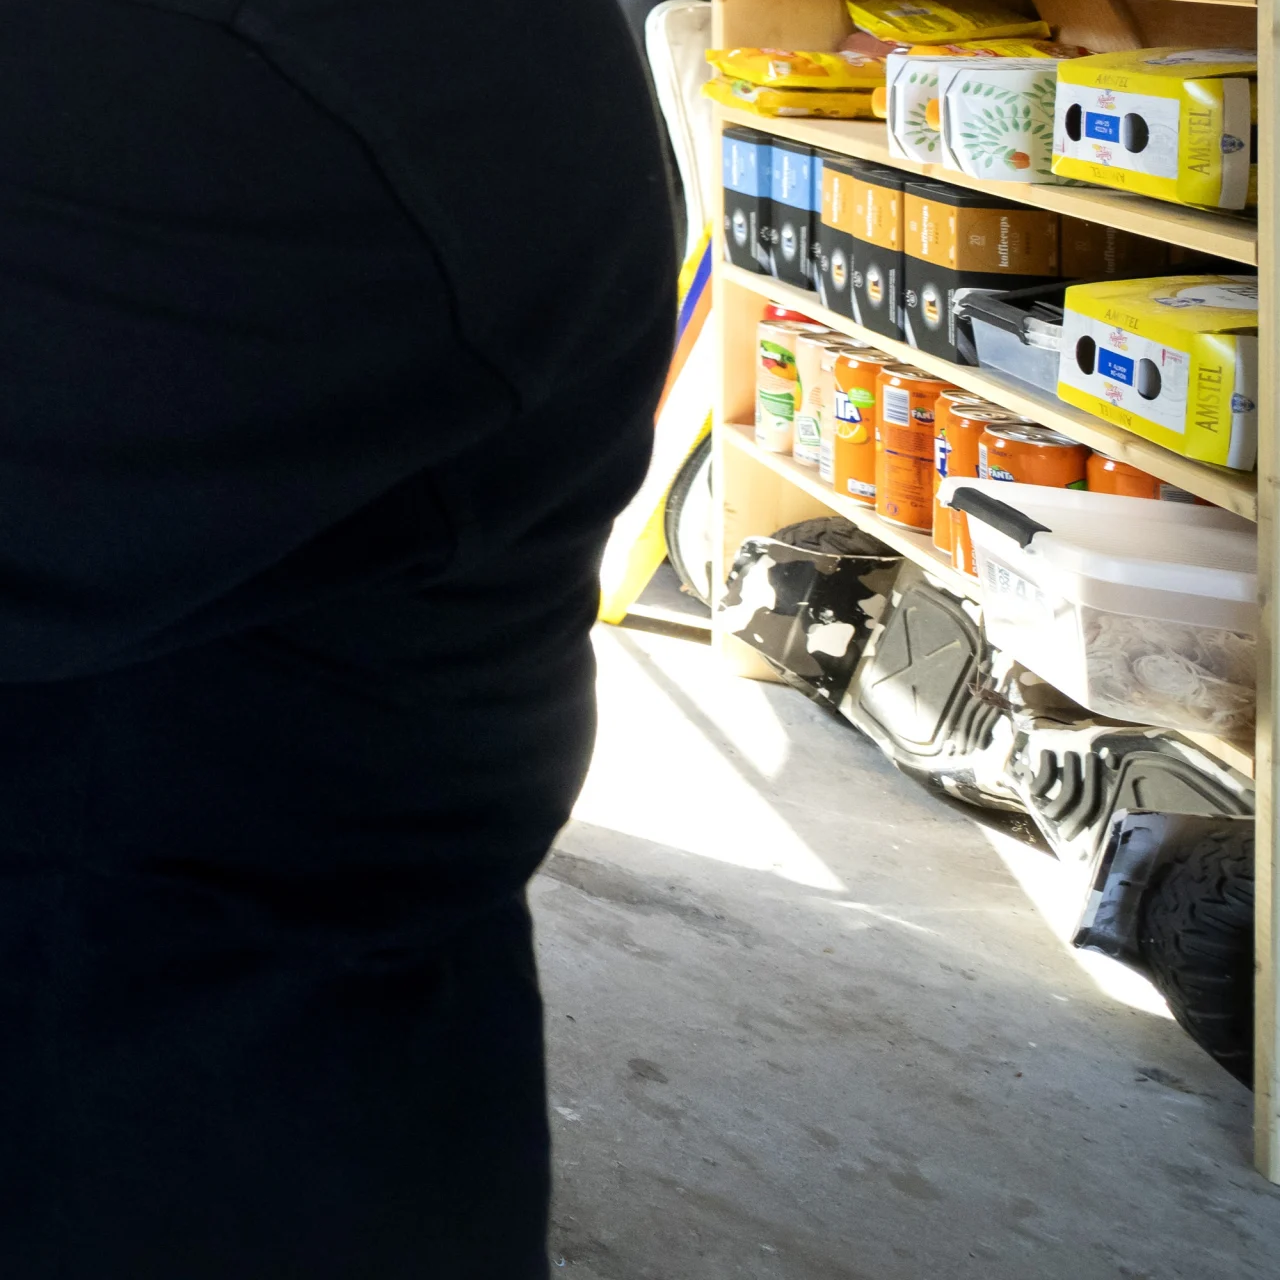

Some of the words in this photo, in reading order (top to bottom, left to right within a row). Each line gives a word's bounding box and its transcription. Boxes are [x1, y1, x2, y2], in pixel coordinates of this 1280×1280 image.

[1095, 74, 1129, 88] AMSTEL
[1187, 108, 1212, 176] AMSTEL
[1104, 308, 1139, 330] AMSTEL
[1196, 365, 1223, 433] AMSTEL
[988, 466, 1014, 481] FANTA
